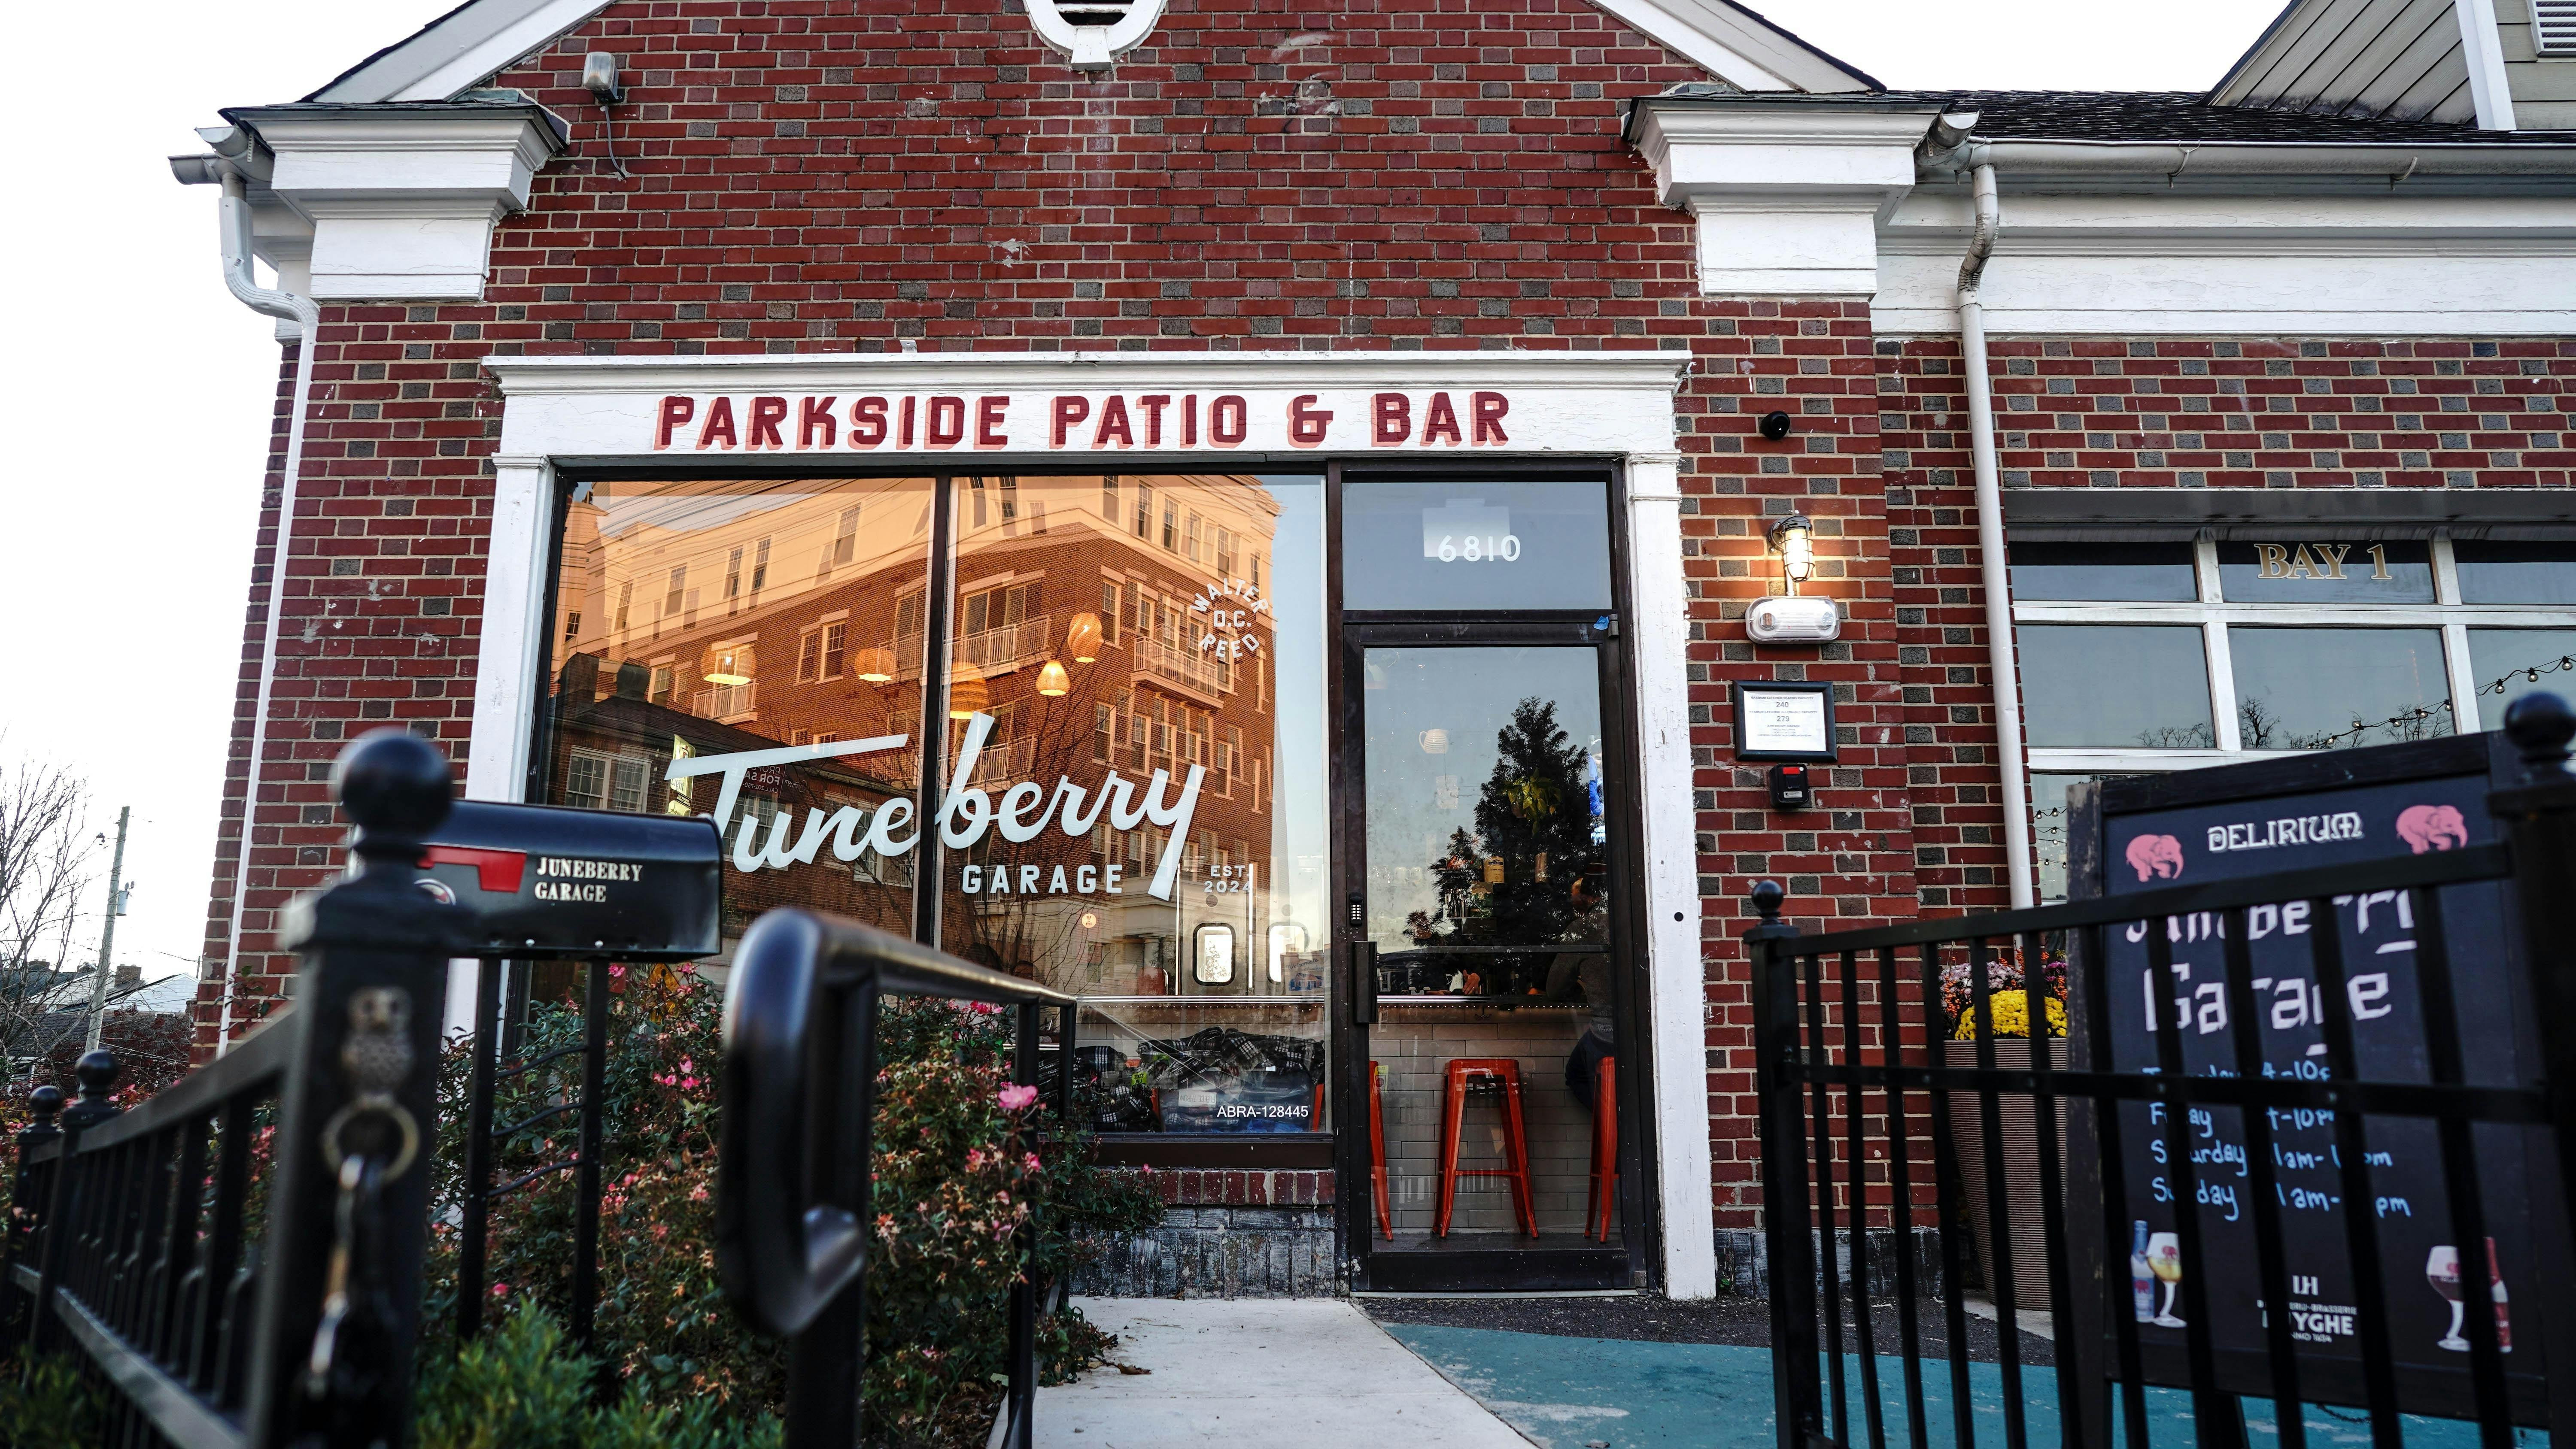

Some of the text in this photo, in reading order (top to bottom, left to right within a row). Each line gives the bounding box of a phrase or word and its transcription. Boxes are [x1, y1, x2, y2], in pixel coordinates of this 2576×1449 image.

[653, 391, 1509, 451] PARKSIDE PATIO & BAR
[1438, 535, 1521, 562] 6810
[2254, 543, 2392, 580] BAY 1
[1190, 578, 1269, 614] WALTER
[1214, 610, 1252, 627] D.C.
[1198, 632, 1260, 658] REED
[671, 778, 684, 792] Light
[2207, 811, 2364, 852] DELIRIUM
[536, 857, 643, 882] JUNEBERRY
[962, 864, 1123, 894] GARAGE
[534, 882, 607, 903] GARAGE
[1216, 1105, 1309, 1118] ABRA-128445
